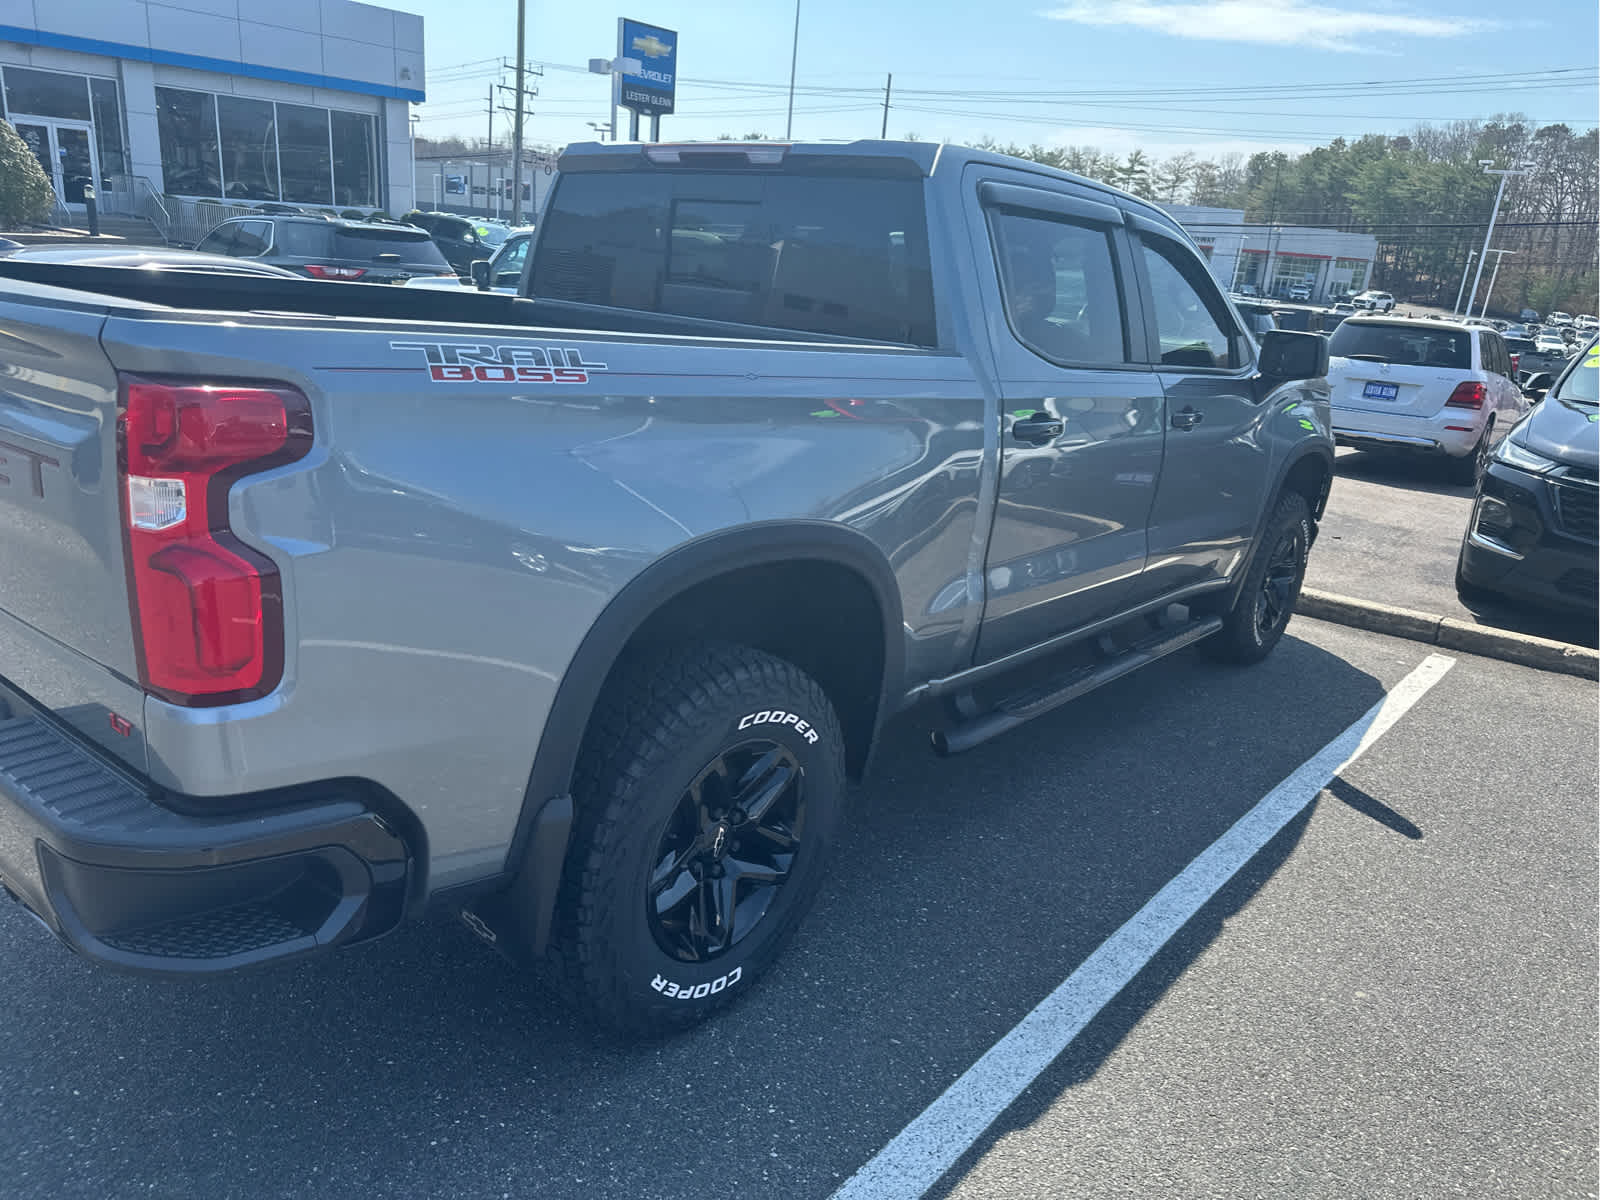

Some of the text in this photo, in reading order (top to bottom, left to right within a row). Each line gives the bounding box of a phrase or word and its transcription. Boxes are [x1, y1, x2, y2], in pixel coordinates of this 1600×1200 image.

[626, 90, 672, 107] LESTER GLENN
[389, 341, 608, 370] TRAIL
[428, 364, 589, 384] BOSS
[738, 710, 819, 745] COOPER
[650, 966, 742, 999] COOPER
